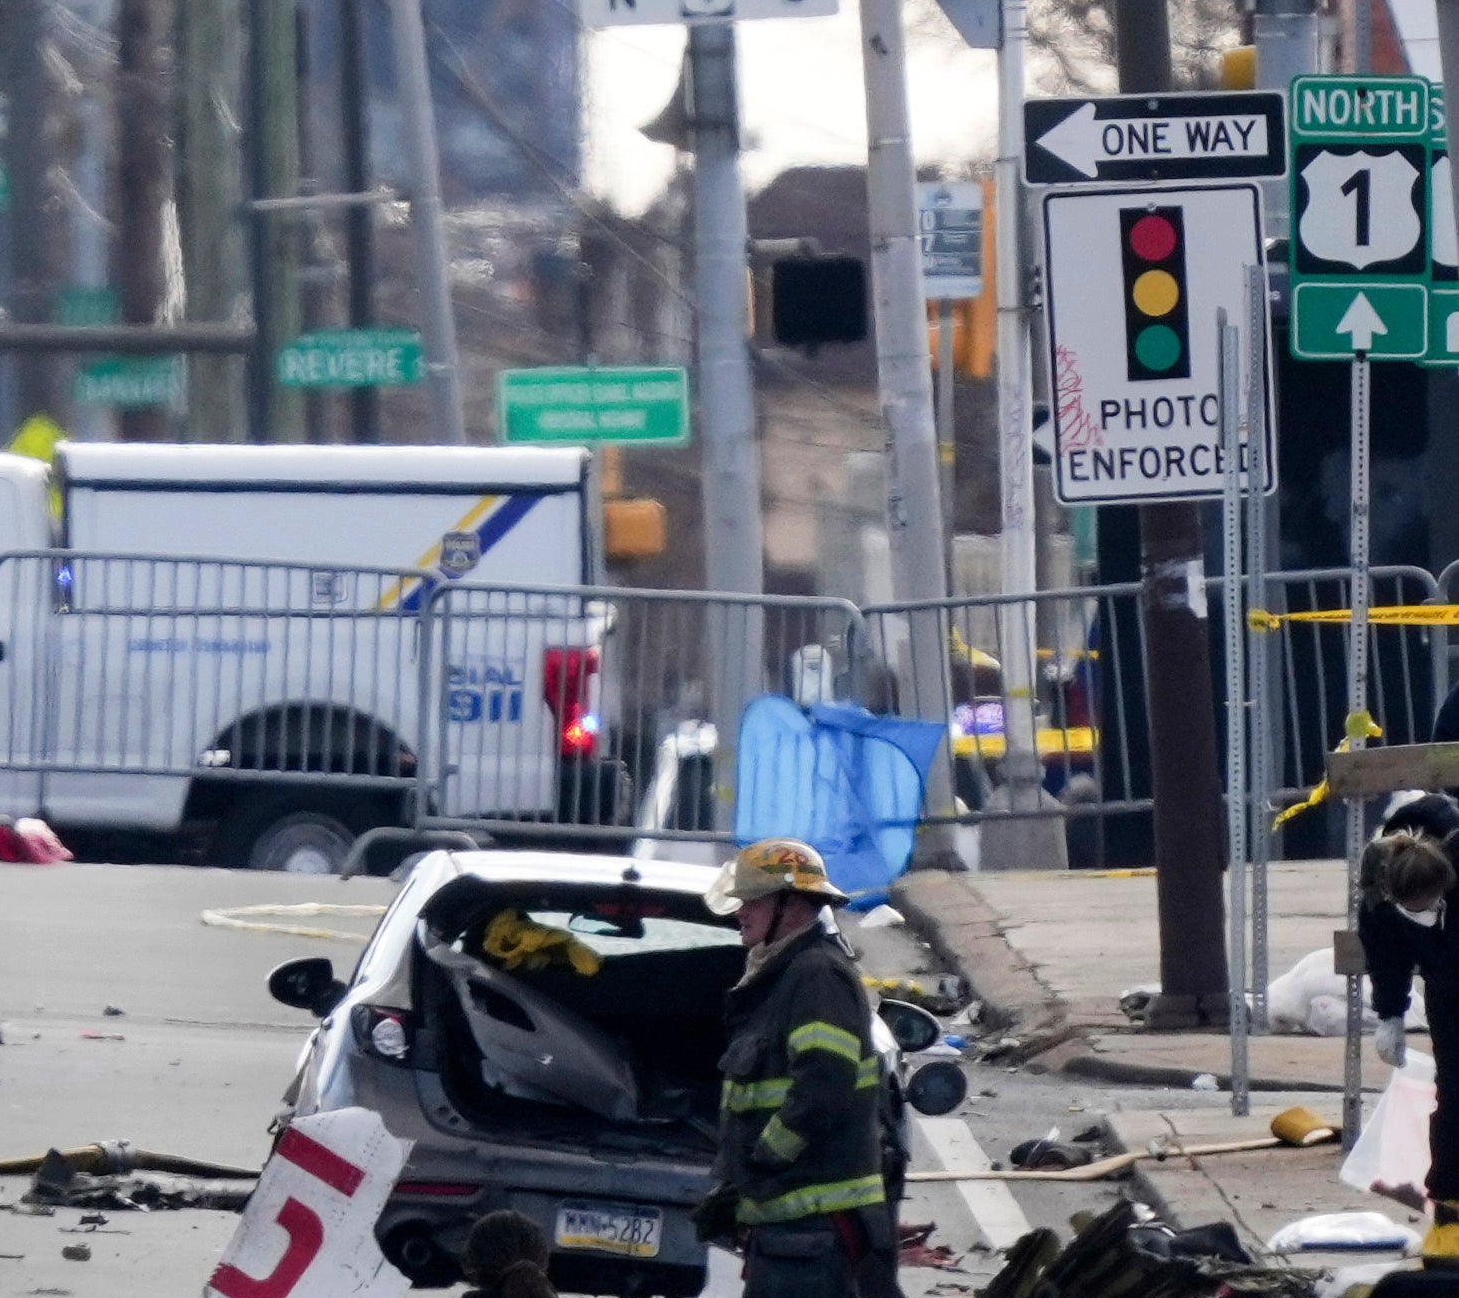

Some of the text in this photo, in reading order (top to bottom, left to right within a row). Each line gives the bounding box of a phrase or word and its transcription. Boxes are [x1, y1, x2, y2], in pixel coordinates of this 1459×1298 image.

[1304, 89, 1418, 126] NORTH
[1102, 119, 1258, 155] ONE WAY
[1340, 168, 1372, 246] 1
[1101, 394, 1219, 431] PHOTO
[448, 666, 522, 686] DIAL
[448, 690, 522, 723] 911
